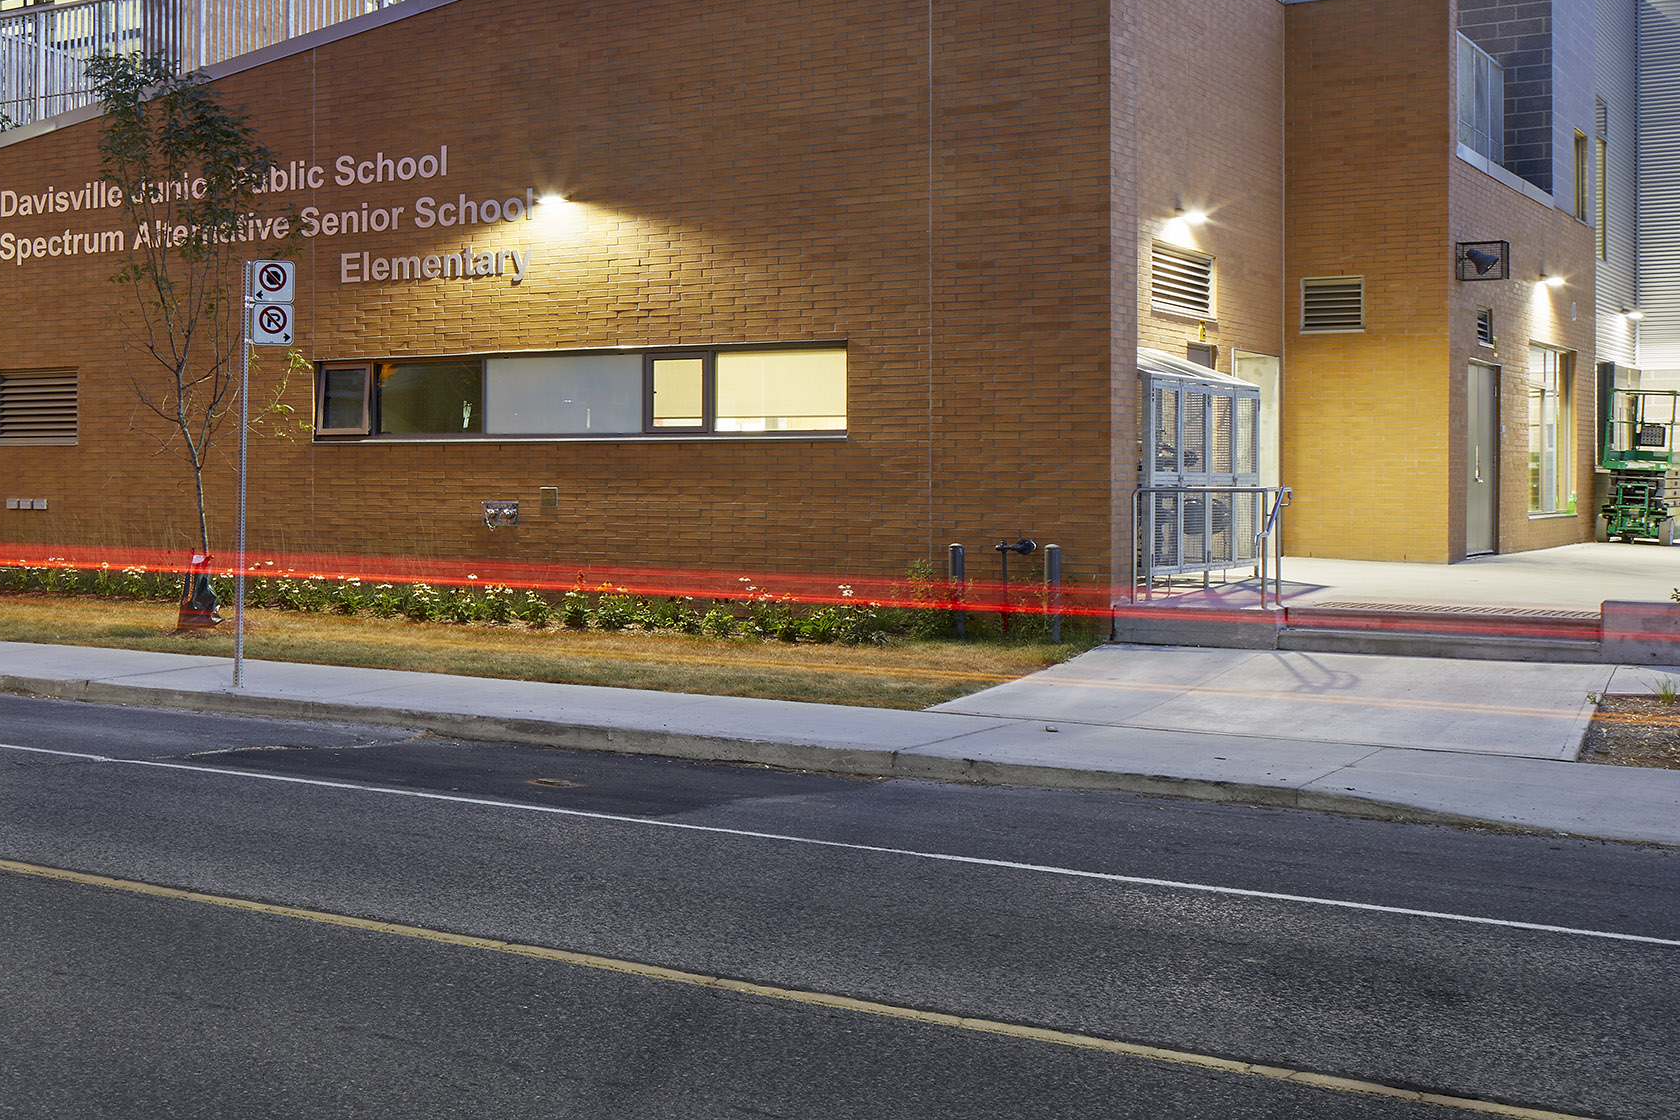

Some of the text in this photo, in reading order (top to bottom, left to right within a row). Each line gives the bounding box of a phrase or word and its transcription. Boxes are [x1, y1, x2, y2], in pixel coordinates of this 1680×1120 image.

[0, 180, 123, 217] Davisville
[131, 172, 219, 205] Junio
[335, 145, 447, 185] School
[0, 187, 533, 266] Spectrum Alternative Senior School
[341, 245, 532, 283] Elementary
